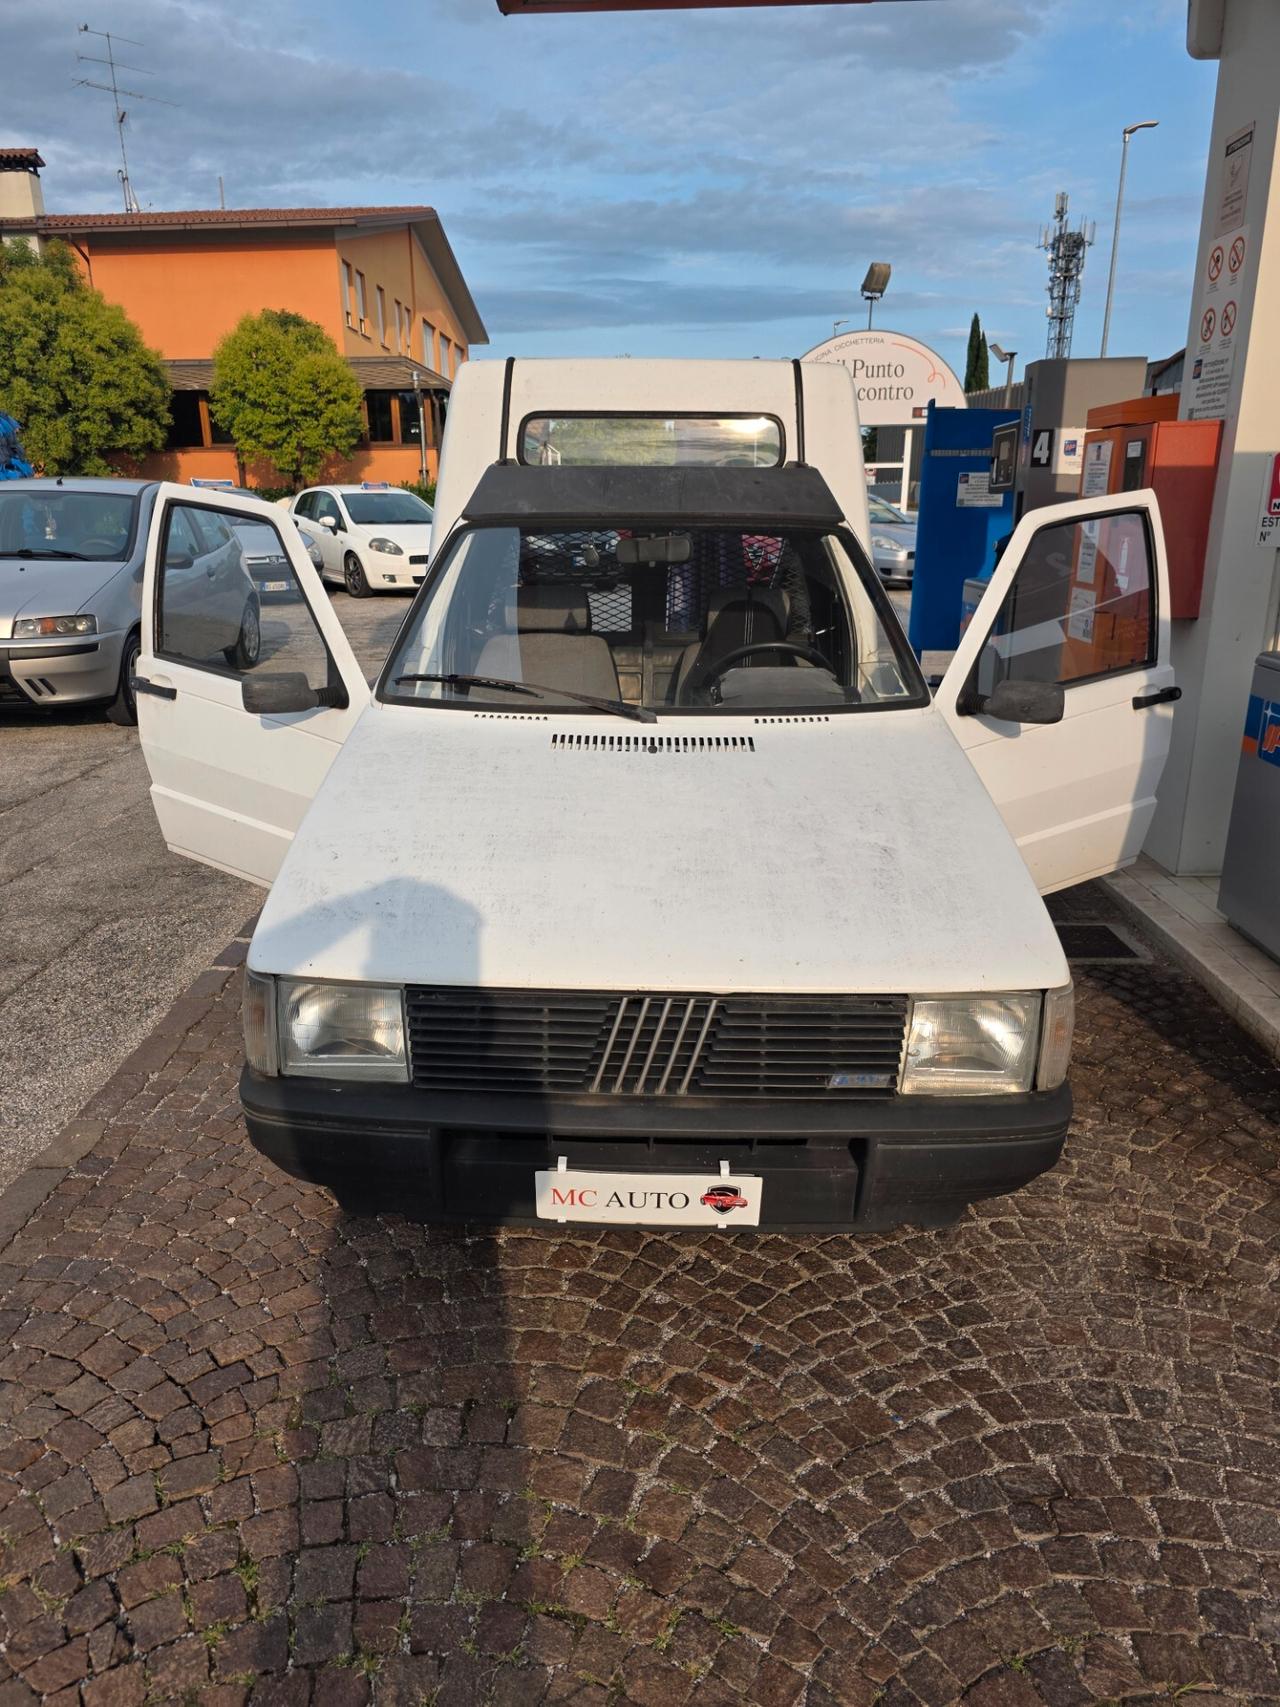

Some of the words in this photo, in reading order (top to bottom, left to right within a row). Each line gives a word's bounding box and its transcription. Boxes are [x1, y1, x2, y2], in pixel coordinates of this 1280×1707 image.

[834, 337, 885, 352] CICCHETTERIA
[852, 358, 905, 379] Punto
[857, 385, 914, 401] contro
[1033, 431, 1050, 464] 4
[1261, 516, 1280, 528] EST
[551, 1188, 598, 1207] MC
[605, 1191, 690, 1210] AUTO
